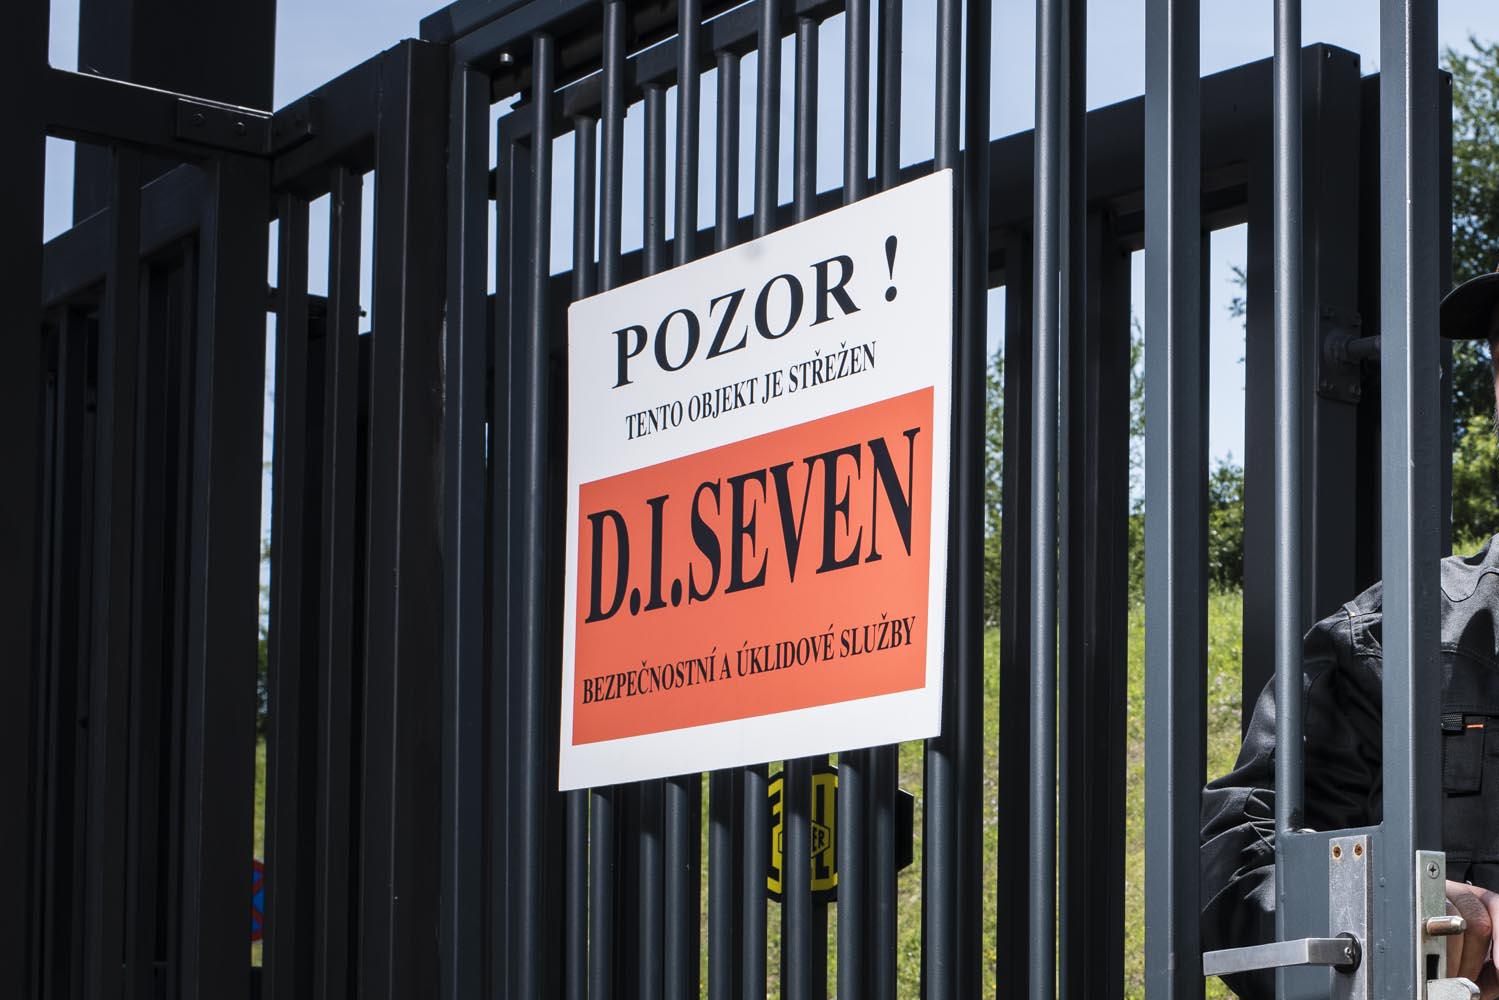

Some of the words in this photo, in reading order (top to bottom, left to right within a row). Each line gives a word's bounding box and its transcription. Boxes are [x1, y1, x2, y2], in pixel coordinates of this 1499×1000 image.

[612, 254, 861, 389] POZOR
[884, 235, 898, 302] !
[625, 401, 683, 440] TENTO
[688, 378, 759, 421] OBJEKT
[761, 371, 784, 404] JE
[788, 341, 877, 394] STŘEŽEN
[585, 427, 921, 624] D.I.SEVEN
[582, 647, 717, 705] BEZPEČNOSTNÍ
[719, 652, 733, 681] A
[737, 624, 835, 677] ÚKLIDOVÉ
[840, 612, 916, 659] SLUŽBY
